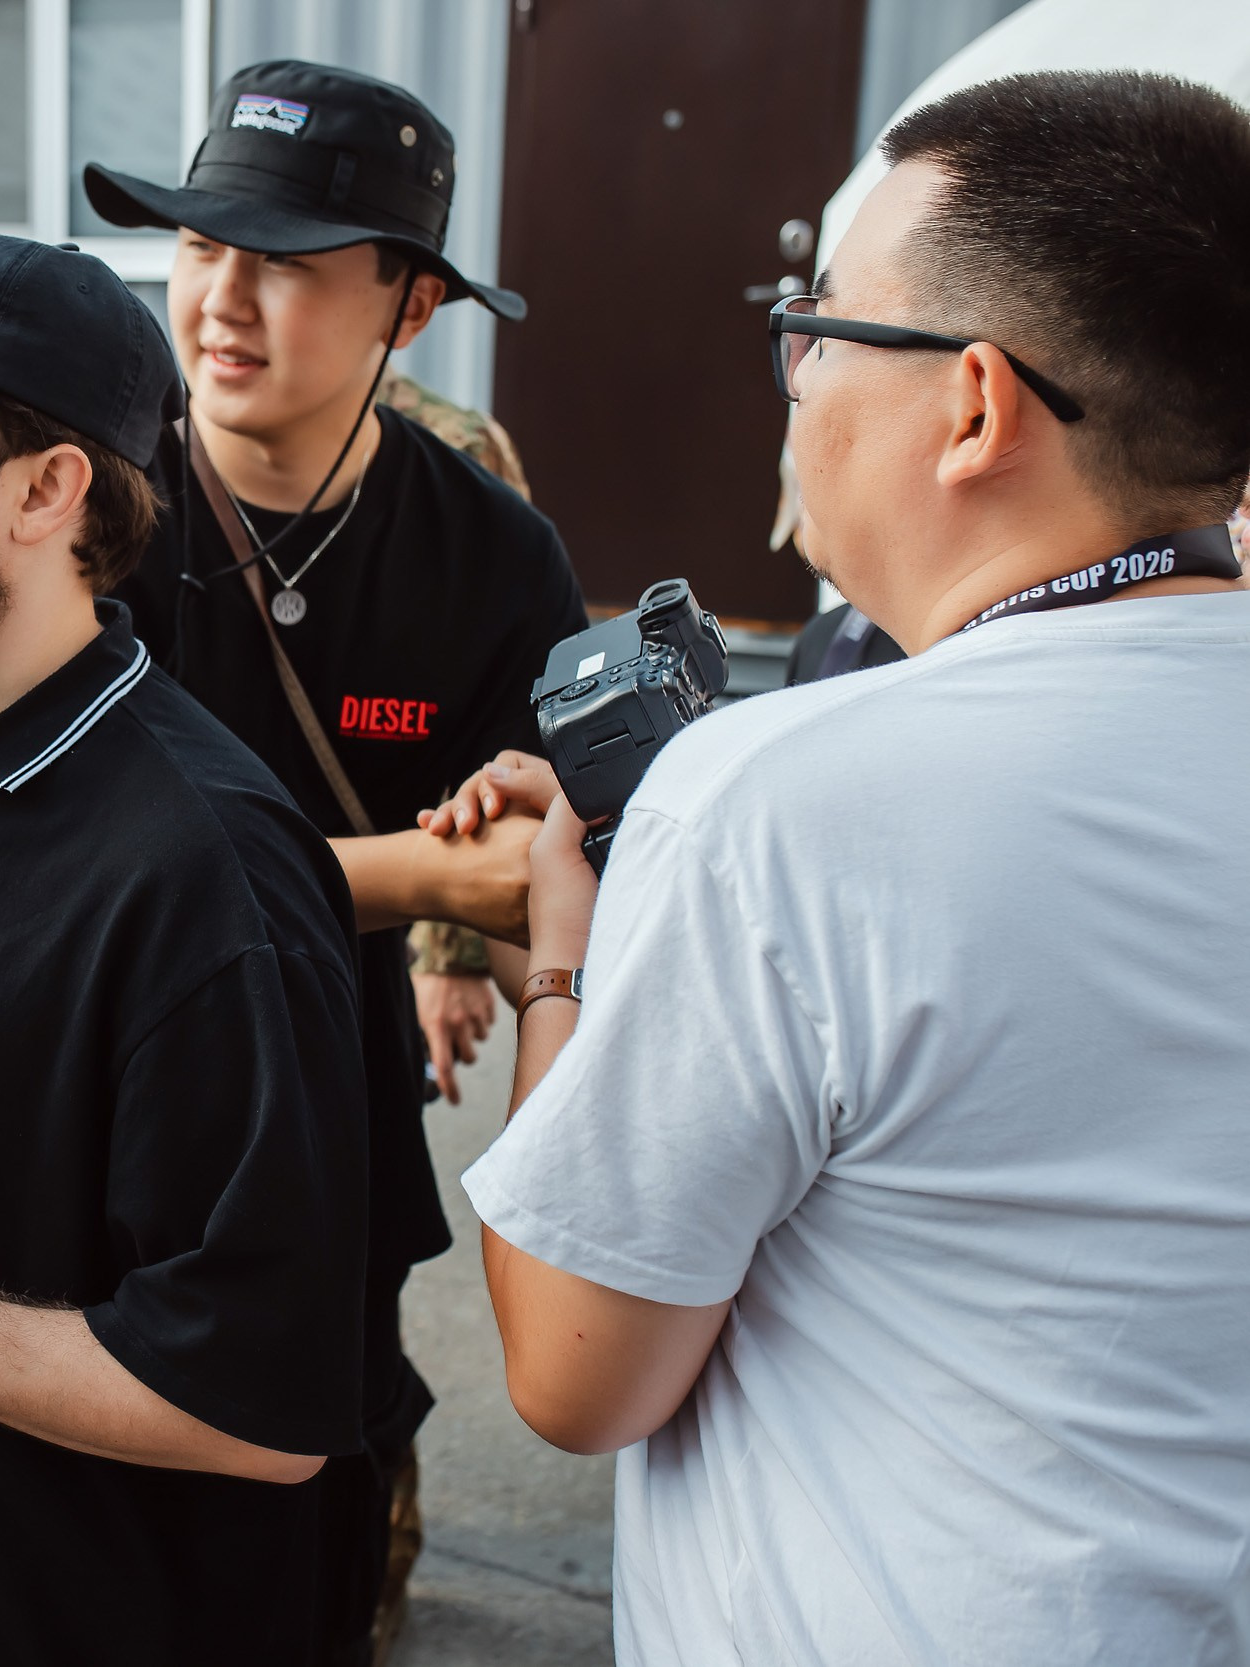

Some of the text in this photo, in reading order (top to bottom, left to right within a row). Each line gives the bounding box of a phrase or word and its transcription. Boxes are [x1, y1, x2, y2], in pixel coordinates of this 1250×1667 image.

[1052, 548, 1175, 594] CUP 2026
[339, 695, 429, 735] DIESEL
